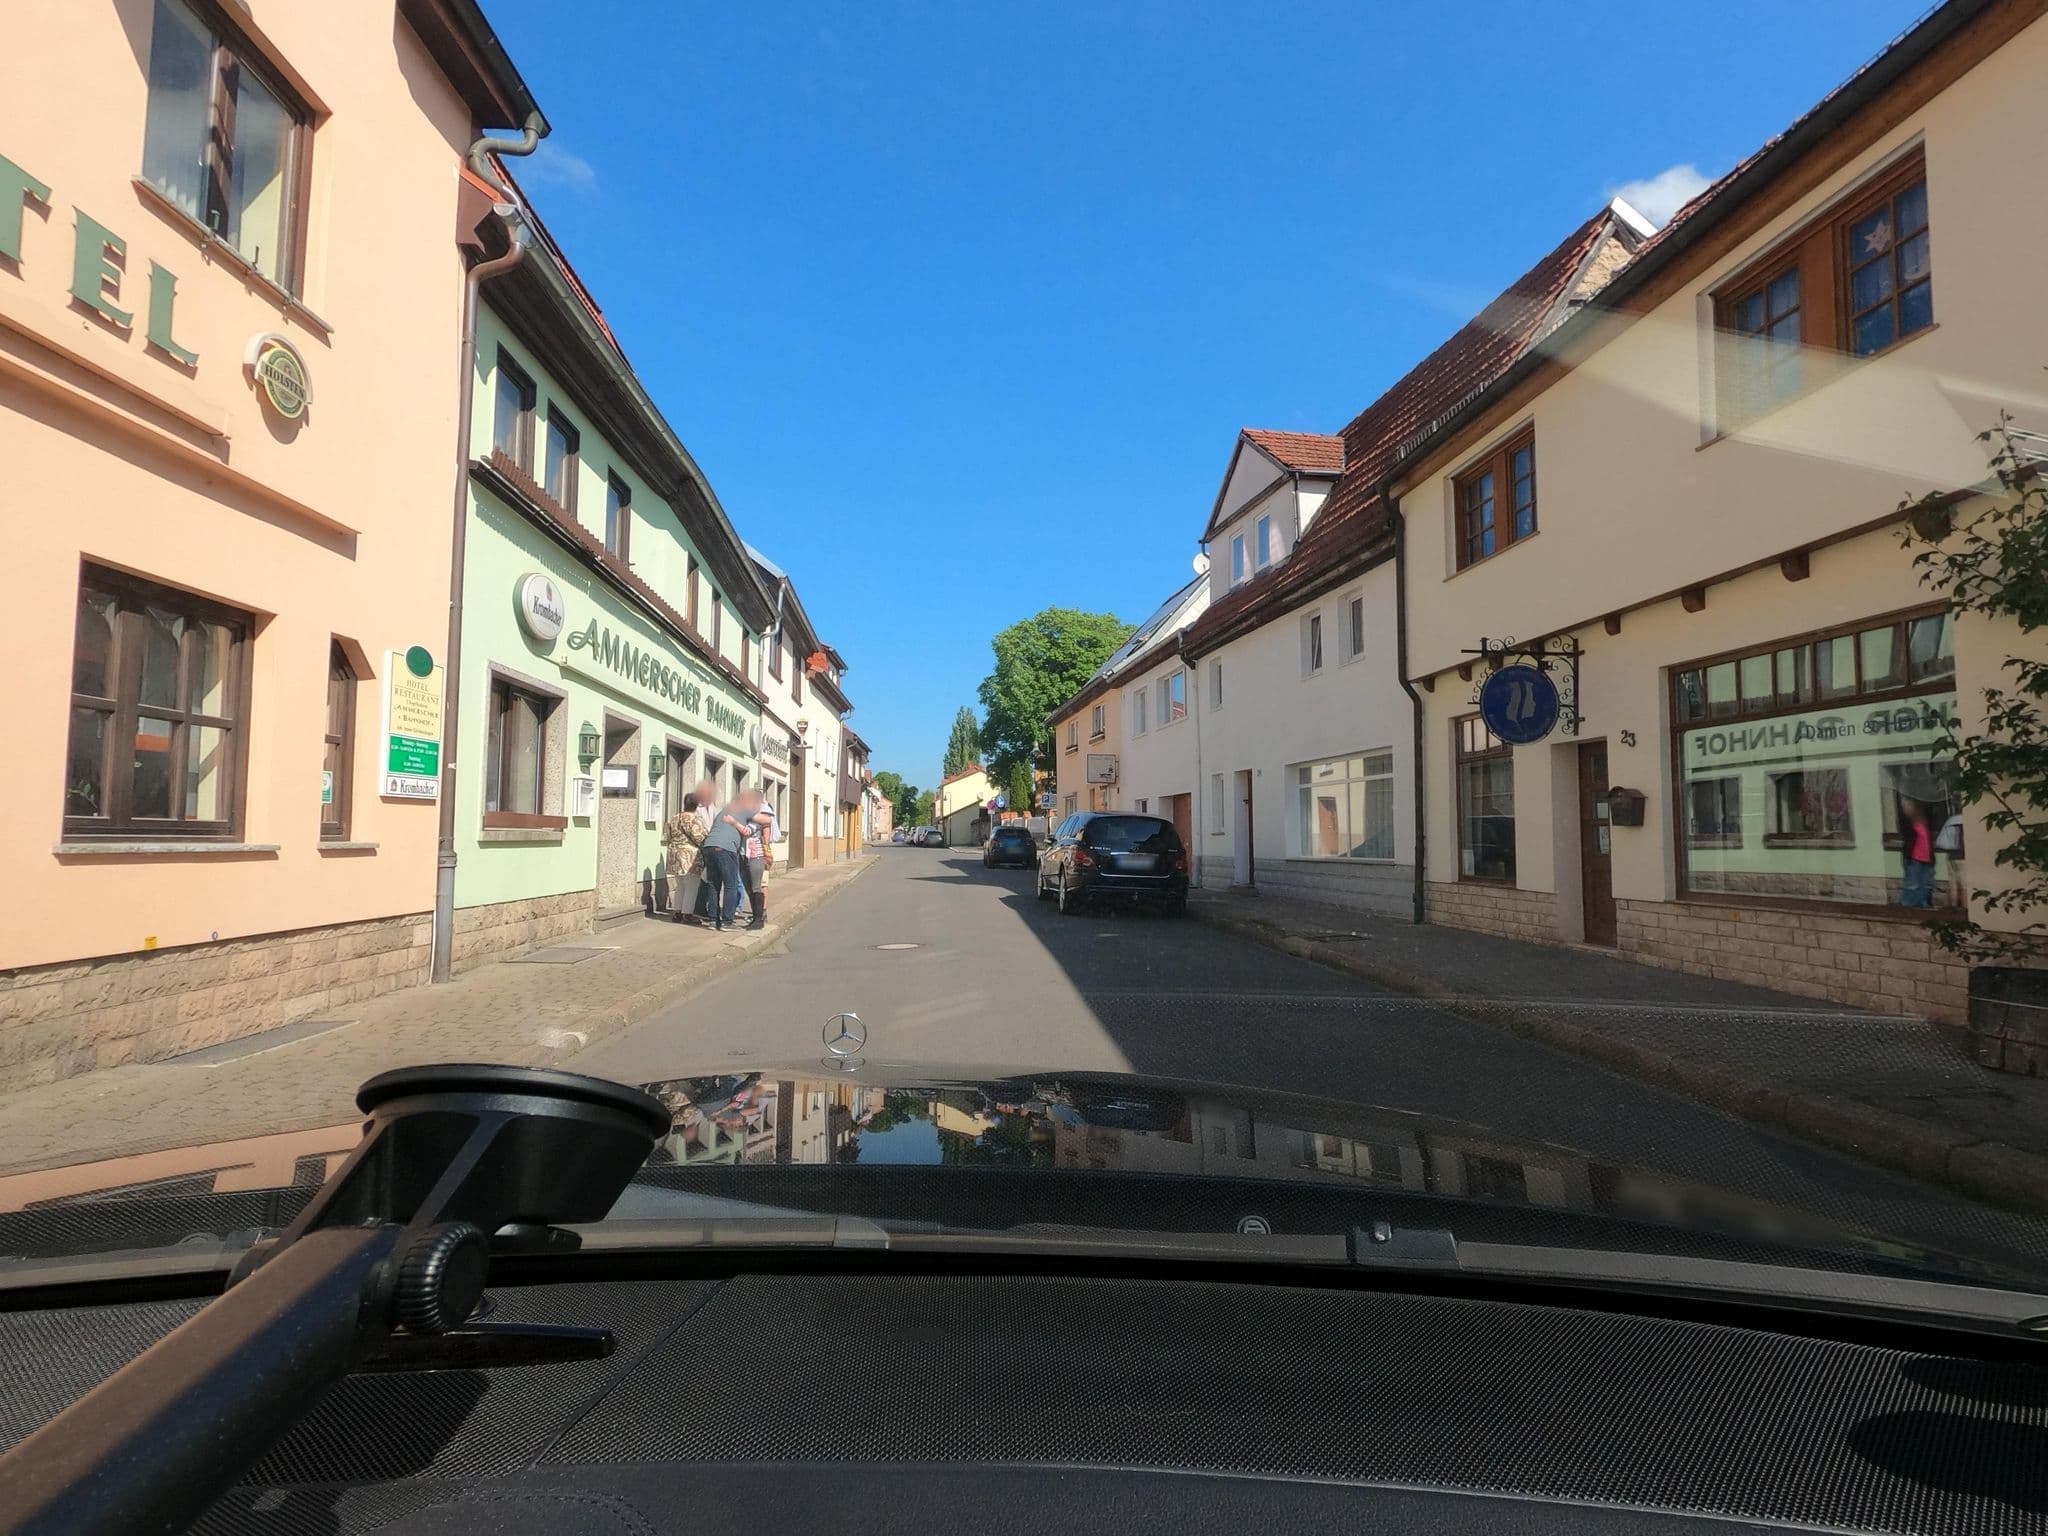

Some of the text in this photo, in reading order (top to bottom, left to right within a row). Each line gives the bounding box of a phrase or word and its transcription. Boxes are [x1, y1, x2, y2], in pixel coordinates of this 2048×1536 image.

[265, 364, 306, 399] HOLSTEN
[533, 595, 562, 627] Krombacher
[407, 680, 428, 692] HOTEL
[566, 618, 747, 740] AMMERSCHER BAHNHOF
[394, 688, 440, 705] RESTAURANT
[1620, 729, 1636, 748] 23
[1806, 724, 1855, 740] Damen
[400, 779, 435, 794] Krombacher
